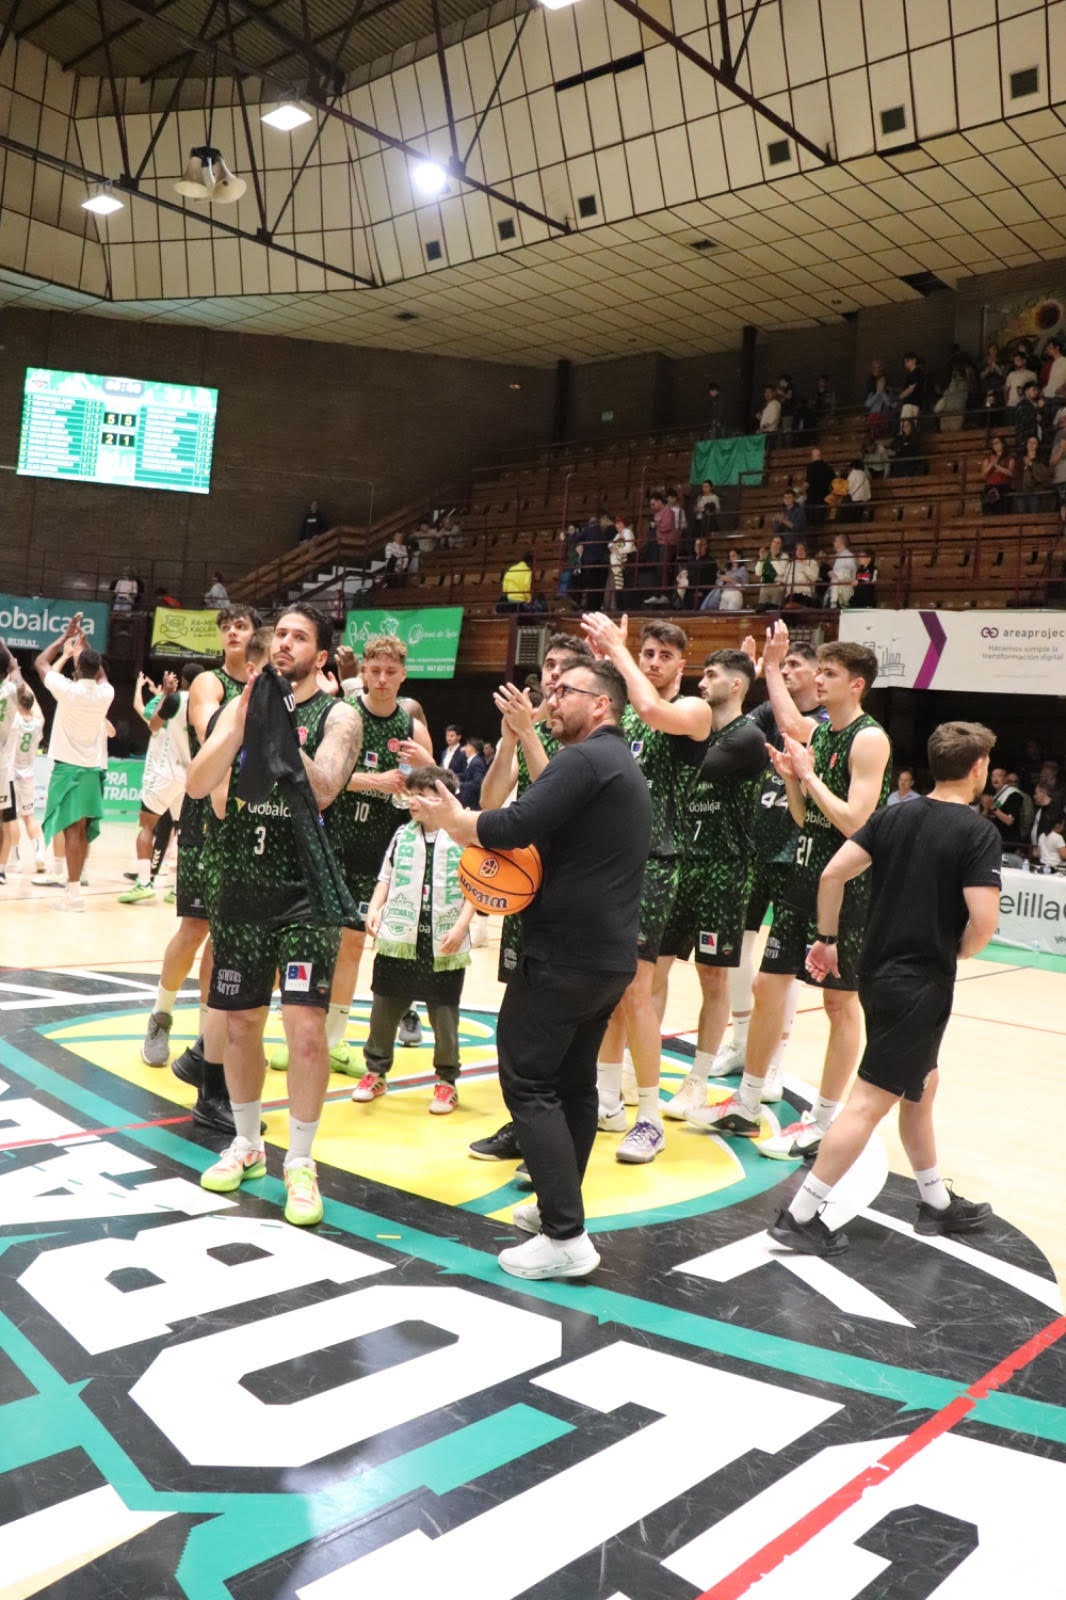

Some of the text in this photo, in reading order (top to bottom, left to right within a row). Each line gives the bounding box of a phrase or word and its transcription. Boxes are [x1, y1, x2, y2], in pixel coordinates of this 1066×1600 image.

[0, 606, 95, 635] obalcaa
[20, 732, 33, 753] 8
[354, 801, 370, 823] 10
[253, 826, 267, 856] 3
[796, 835, 814, 867] 21
